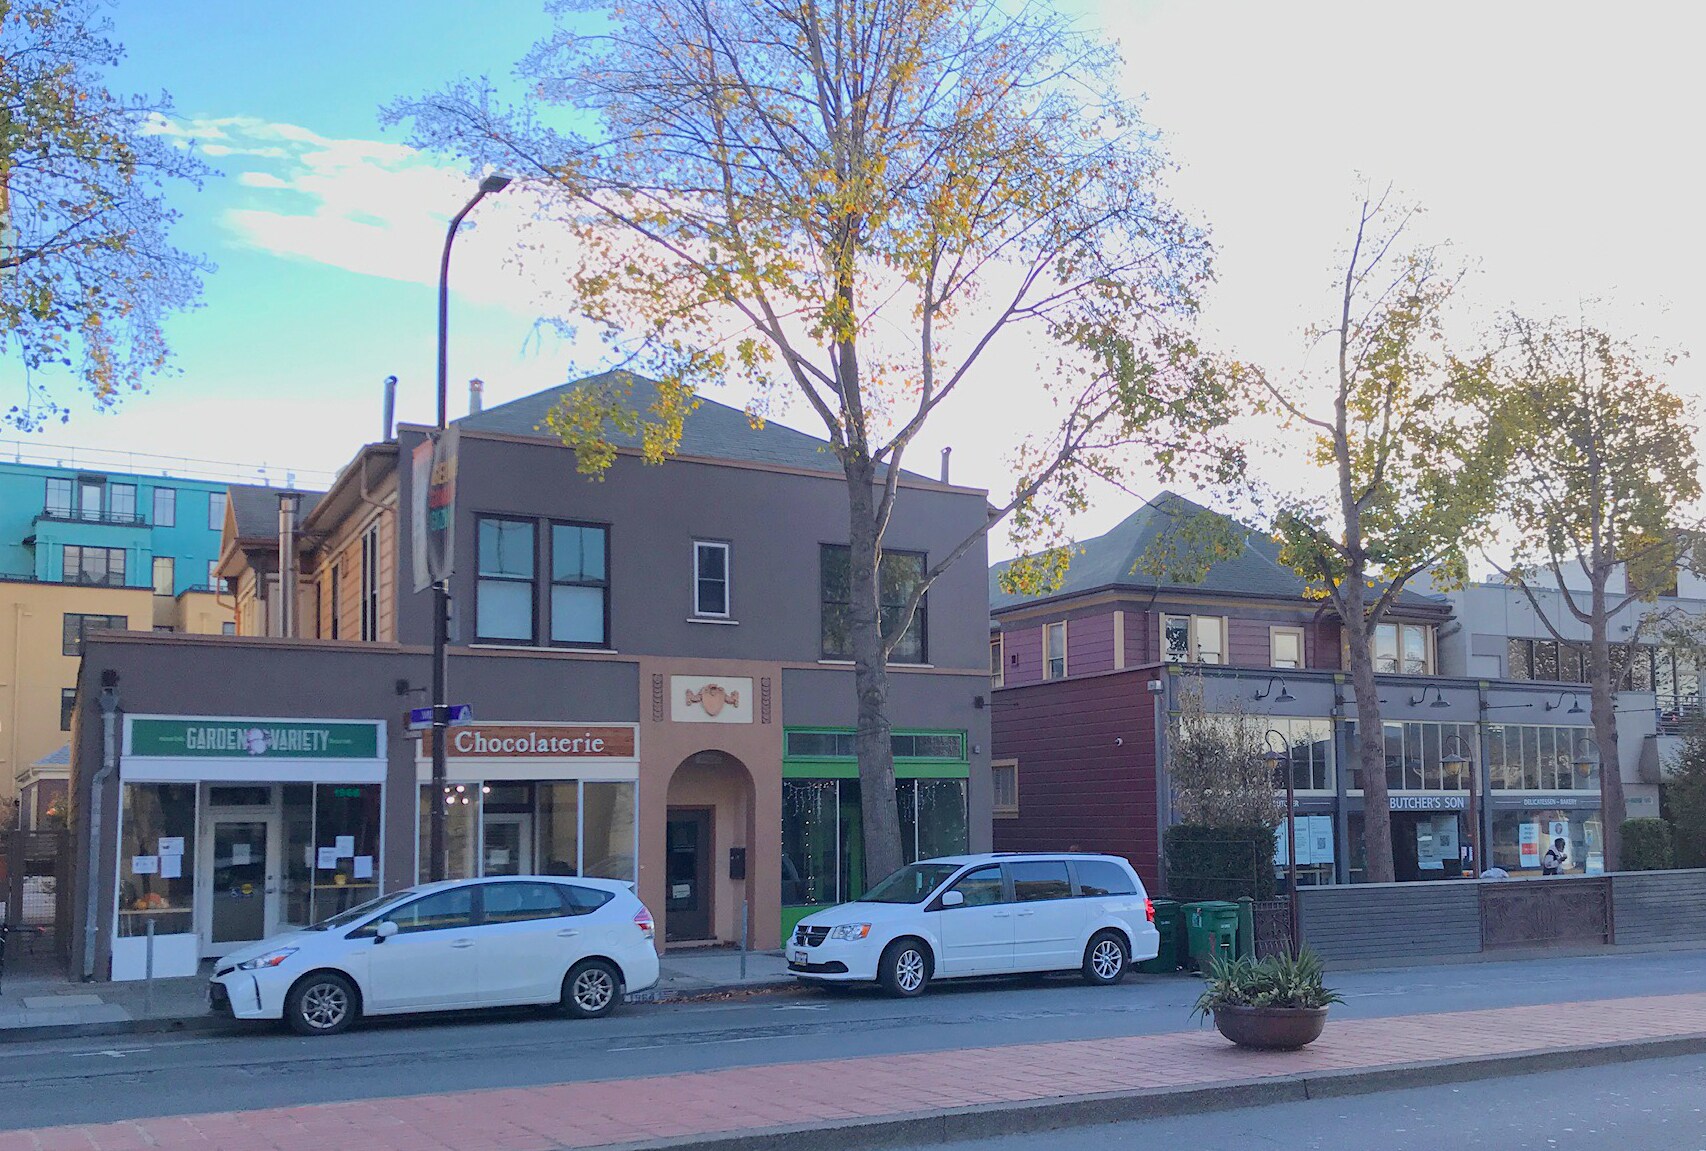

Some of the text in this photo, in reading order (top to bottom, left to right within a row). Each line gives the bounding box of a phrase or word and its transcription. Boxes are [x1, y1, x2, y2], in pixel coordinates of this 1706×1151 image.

[186, 727, 330, 751] GARDEN VARIETY
[454, 730, 605, 753] Chocolaterie
[1390, 797, 1465, 809] BUTCHER'S SON
